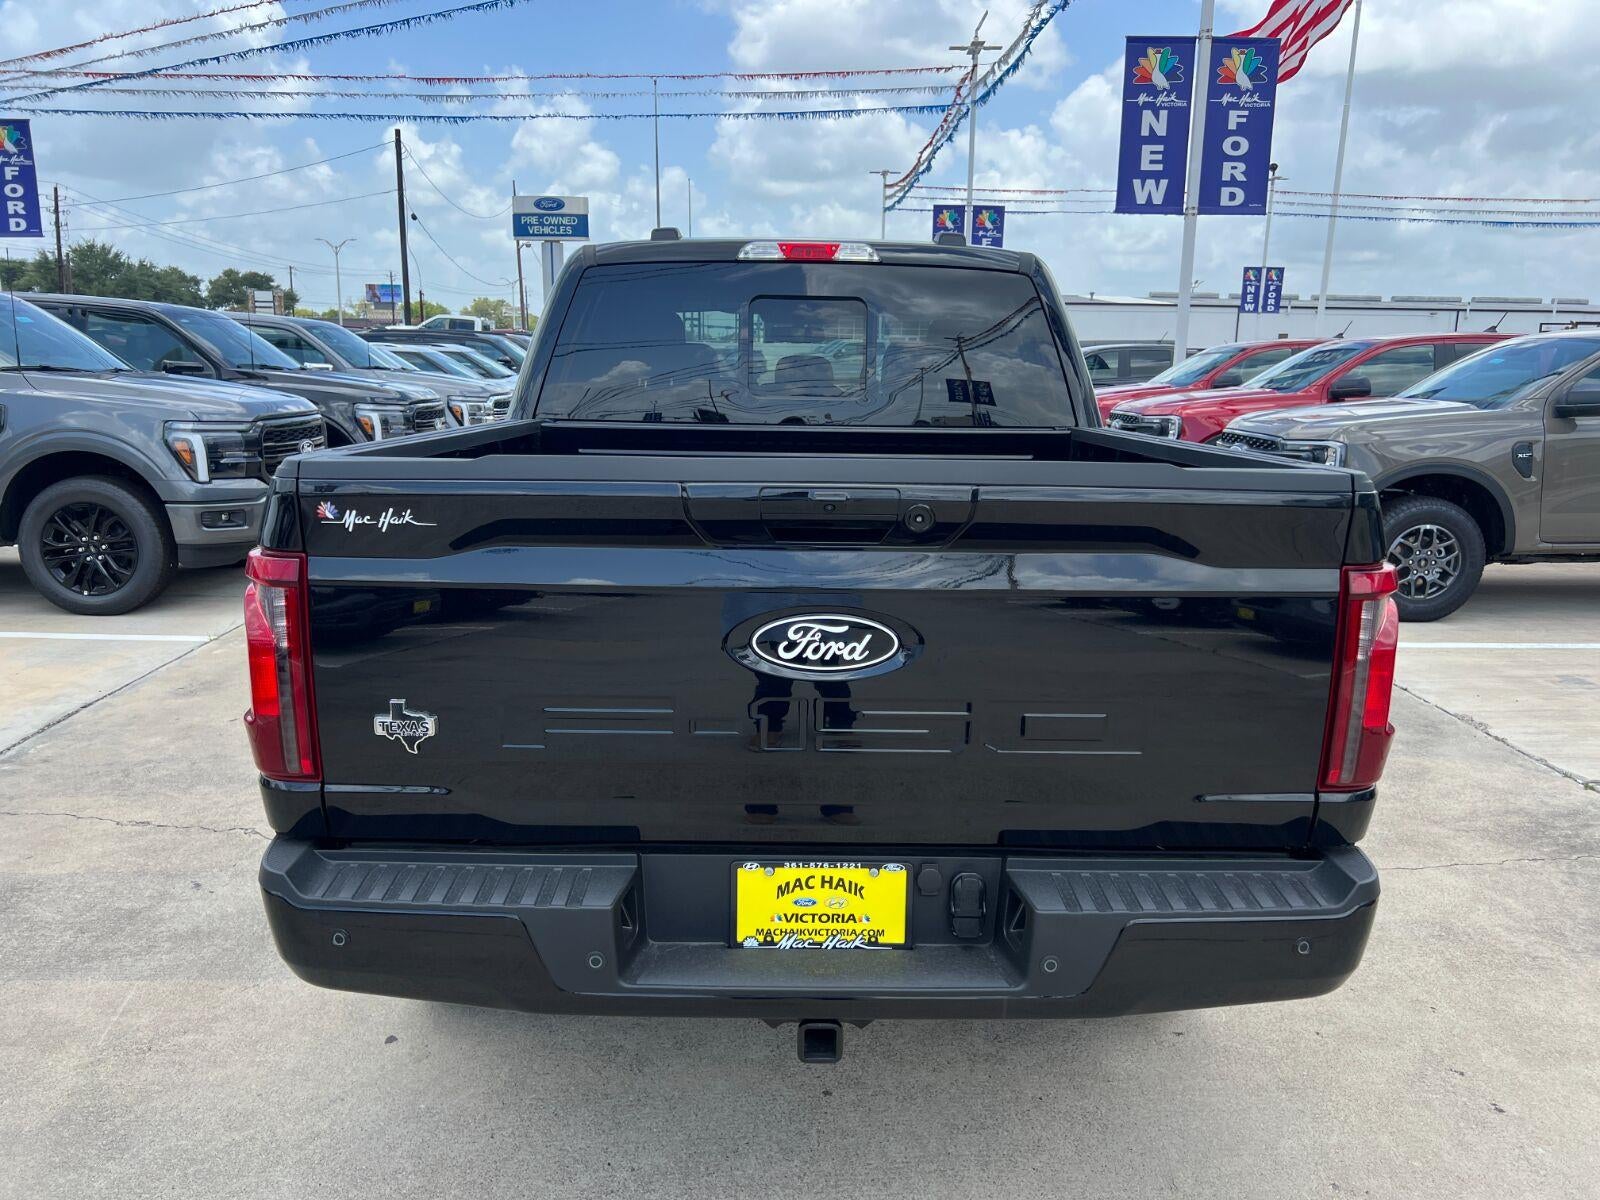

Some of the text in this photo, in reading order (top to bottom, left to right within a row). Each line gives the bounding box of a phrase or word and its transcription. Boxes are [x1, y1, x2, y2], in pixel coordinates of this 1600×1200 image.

[1128, 91, 1186, 107] Mac Haik
[1212, 91, 1270, 107] Mac Haik
[1132, 109, 1169, 205] NEW
[1219, 110, 1250, 207] FORD
[4, 166, 27, 232] FORD
[527, 225, 573, 235] VEHICLES
[1244, 286, 1255, 311] NEW
[1267, 286, 1277, 311] FORD
[324, 507, 434, 533] Mac Haik
[777, 622, 873, 662] Ford
[377, 720, 430, 733] TEXAS
[776, 874, 866, 900] MAC HAIK
[783, 913, 858, 924] VICTORIA
[767, 932, 889, 950] Mac Haik
